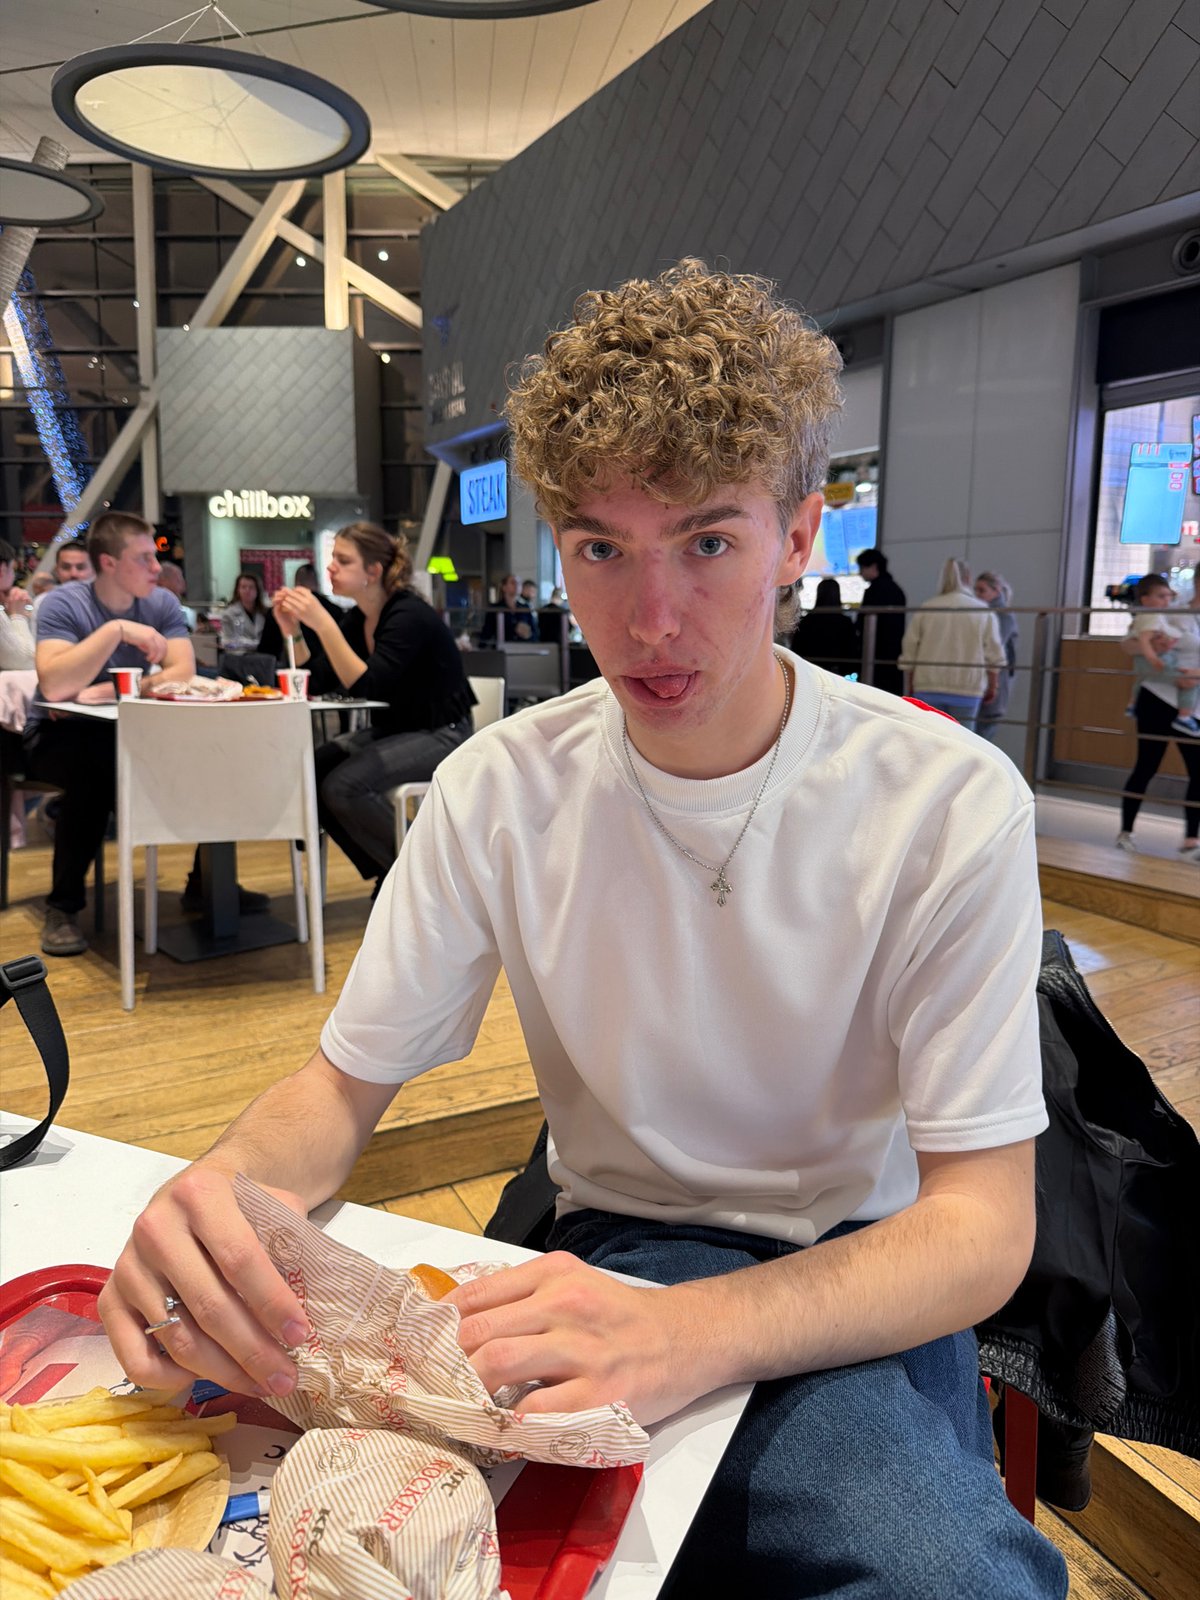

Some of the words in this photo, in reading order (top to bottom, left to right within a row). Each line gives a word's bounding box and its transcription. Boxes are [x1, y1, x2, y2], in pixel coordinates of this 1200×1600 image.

[208, 489, 312, 519] chillbox
[467, 472, 506, 516] STEAK
[377, 1458, 454, 1533] ROCKER
[440, 1467, 470, 1498] KFC
